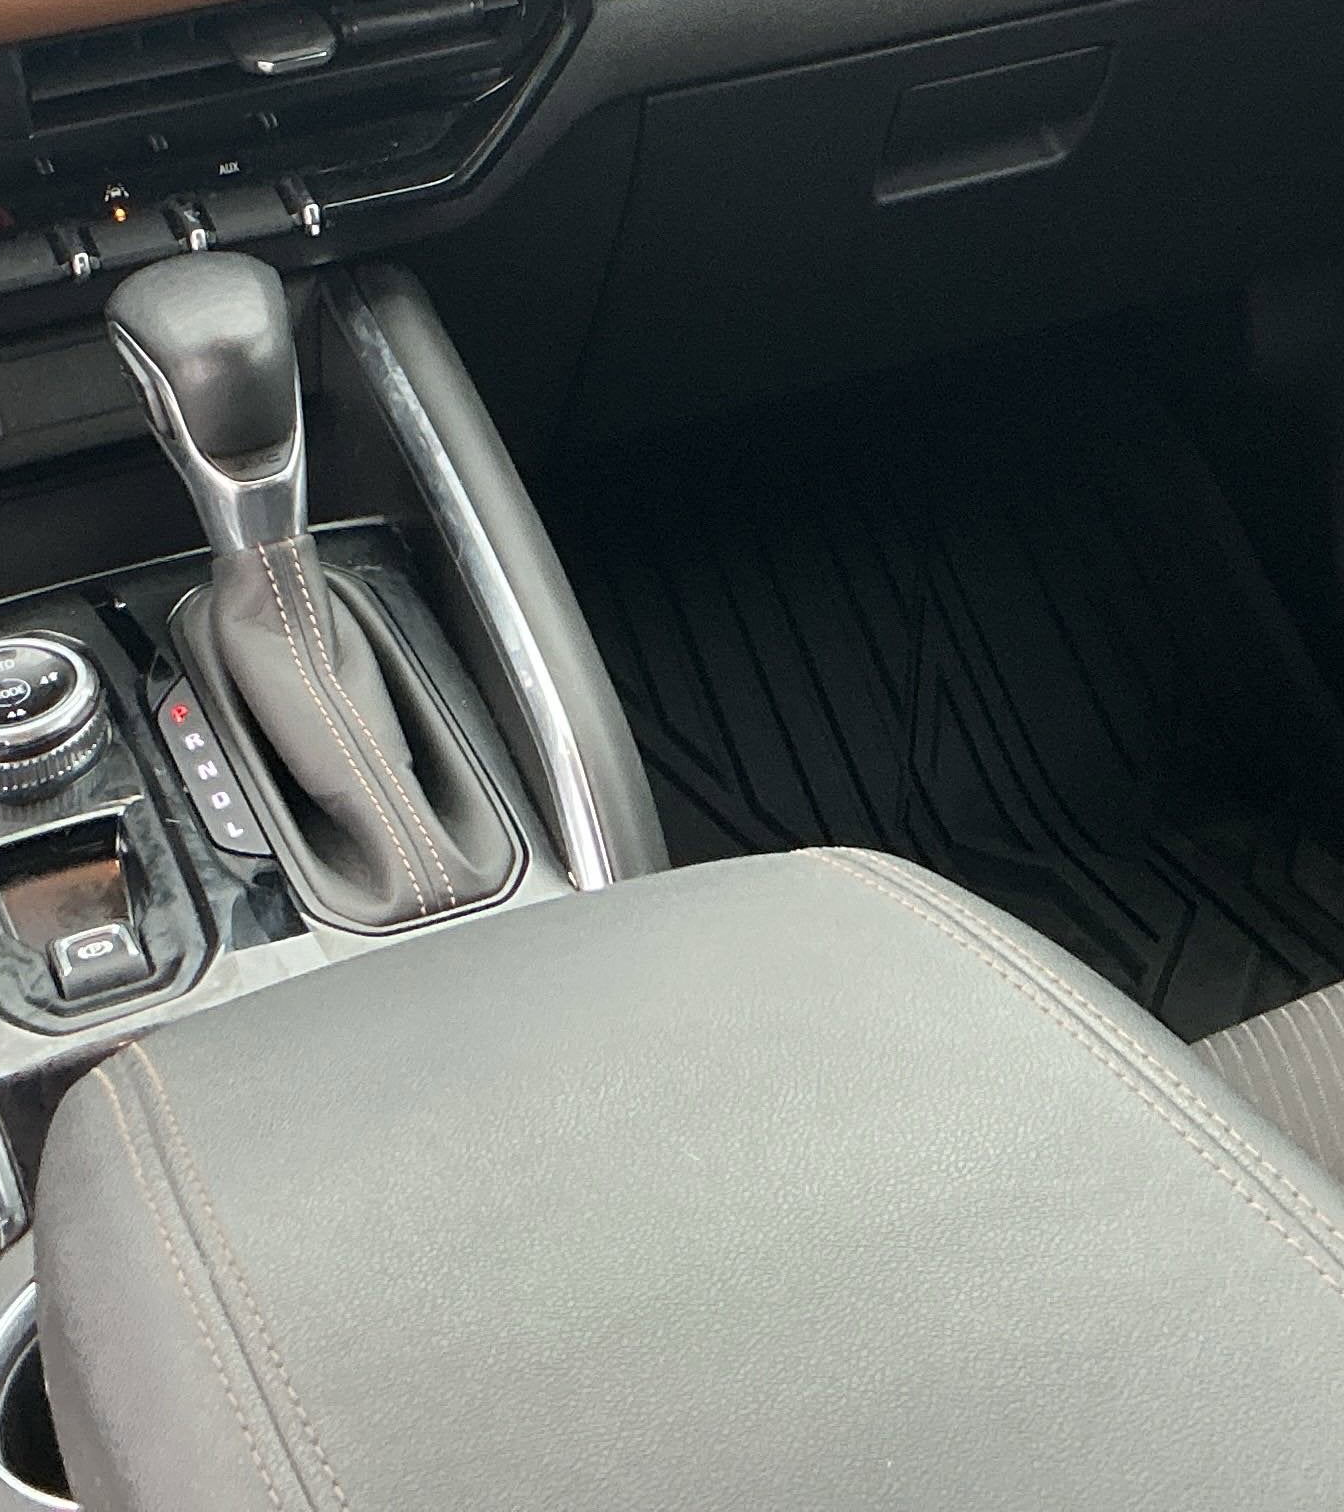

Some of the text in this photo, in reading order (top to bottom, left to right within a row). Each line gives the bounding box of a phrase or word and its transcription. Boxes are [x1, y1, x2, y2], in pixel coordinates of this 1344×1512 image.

[219, 161, 240, 175] AUX
[184, 732, 205, 751] R
[197, 760, 218, 780] N
[211, 791, 232, 810] D
[226, 821, 244, 838] L
